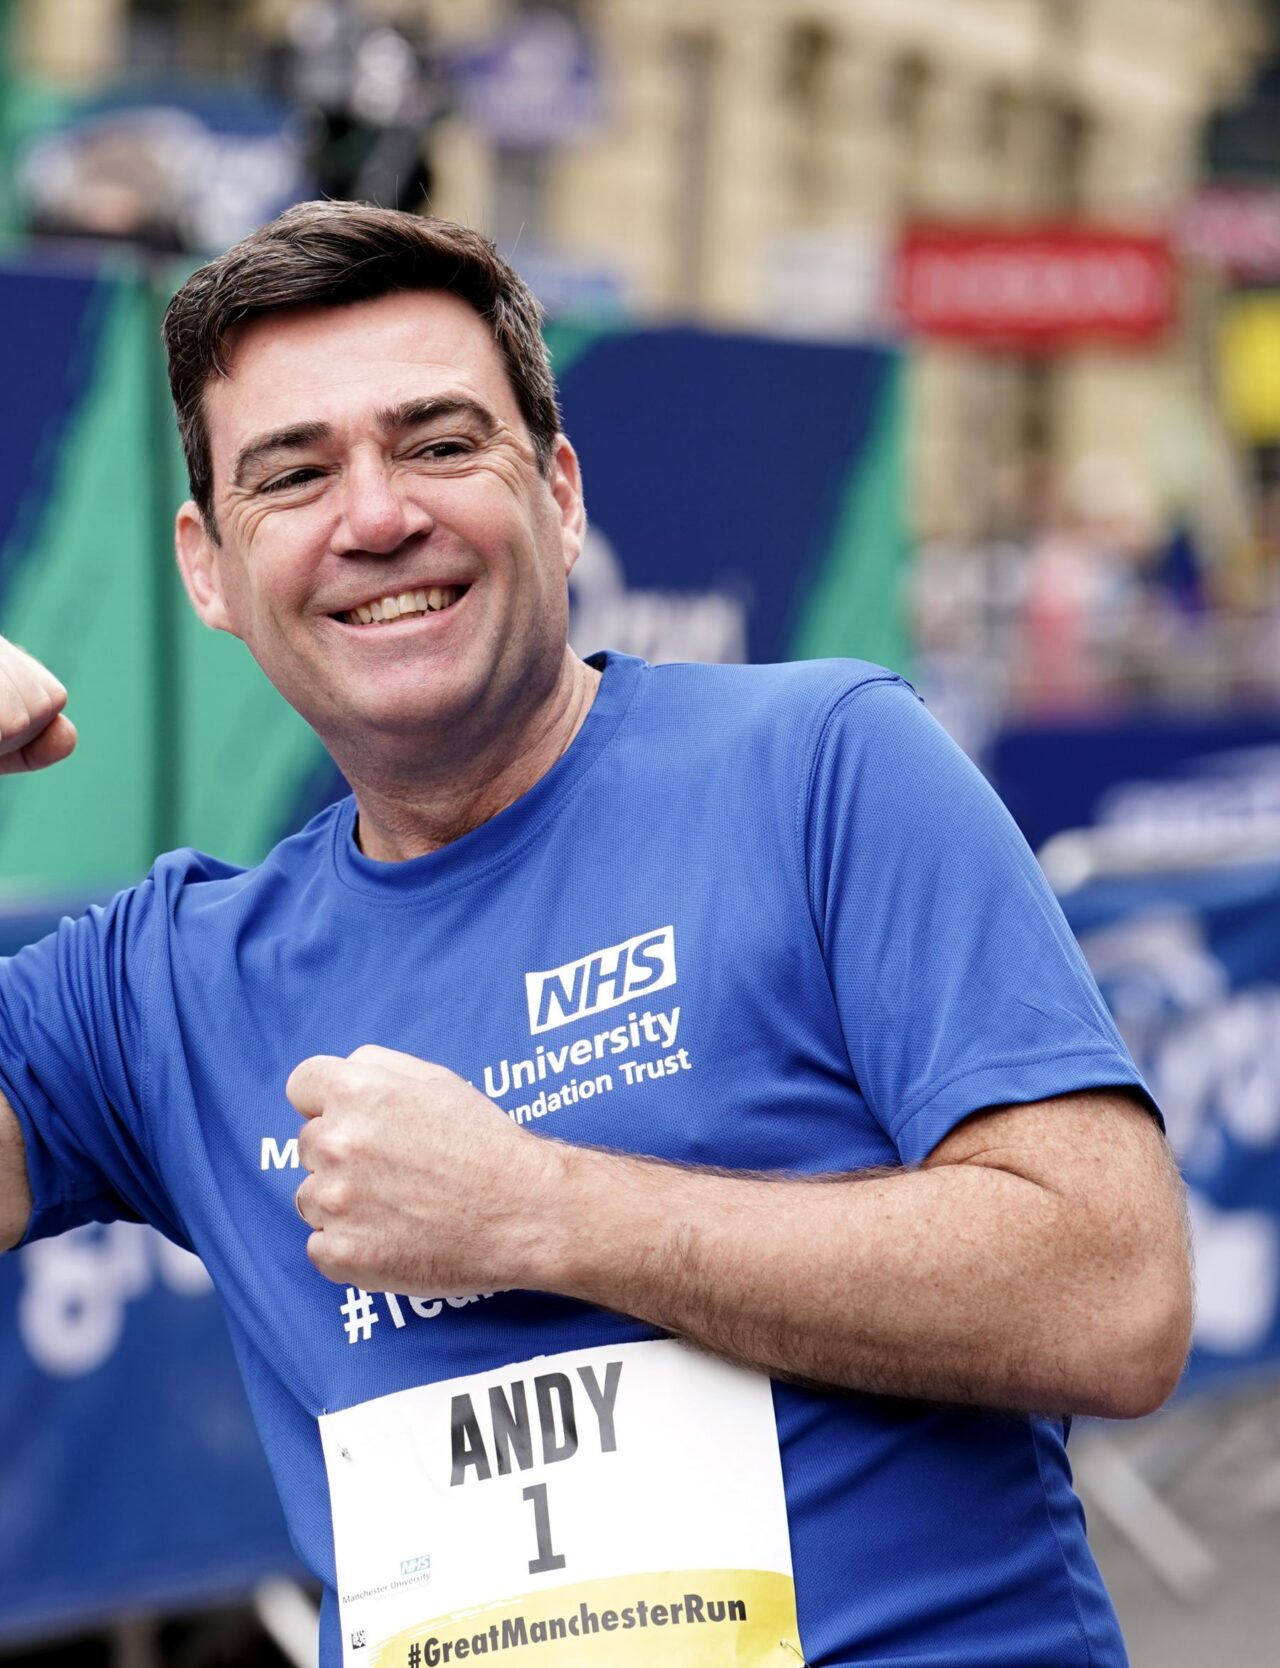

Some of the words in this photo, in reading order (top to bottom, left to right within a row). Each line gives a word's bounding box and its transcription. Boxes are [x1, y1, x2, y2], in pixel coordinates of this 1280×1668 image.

[534, 932, 668, 1029] NHS
[483, 1006, 681, 1098] University
[618, 1047, 693, 1086] Trust
[449, 1360, 624, 1488] ANDY
[400, 1555, 430, 1574] NHS
[521, 1482, 567, 1576] 1
[342, 1585, 388, 1604] Manchester
[390, 1573, 431, 1590] University
[407, 1593, 749, 1668] #GreatManchesterRun
